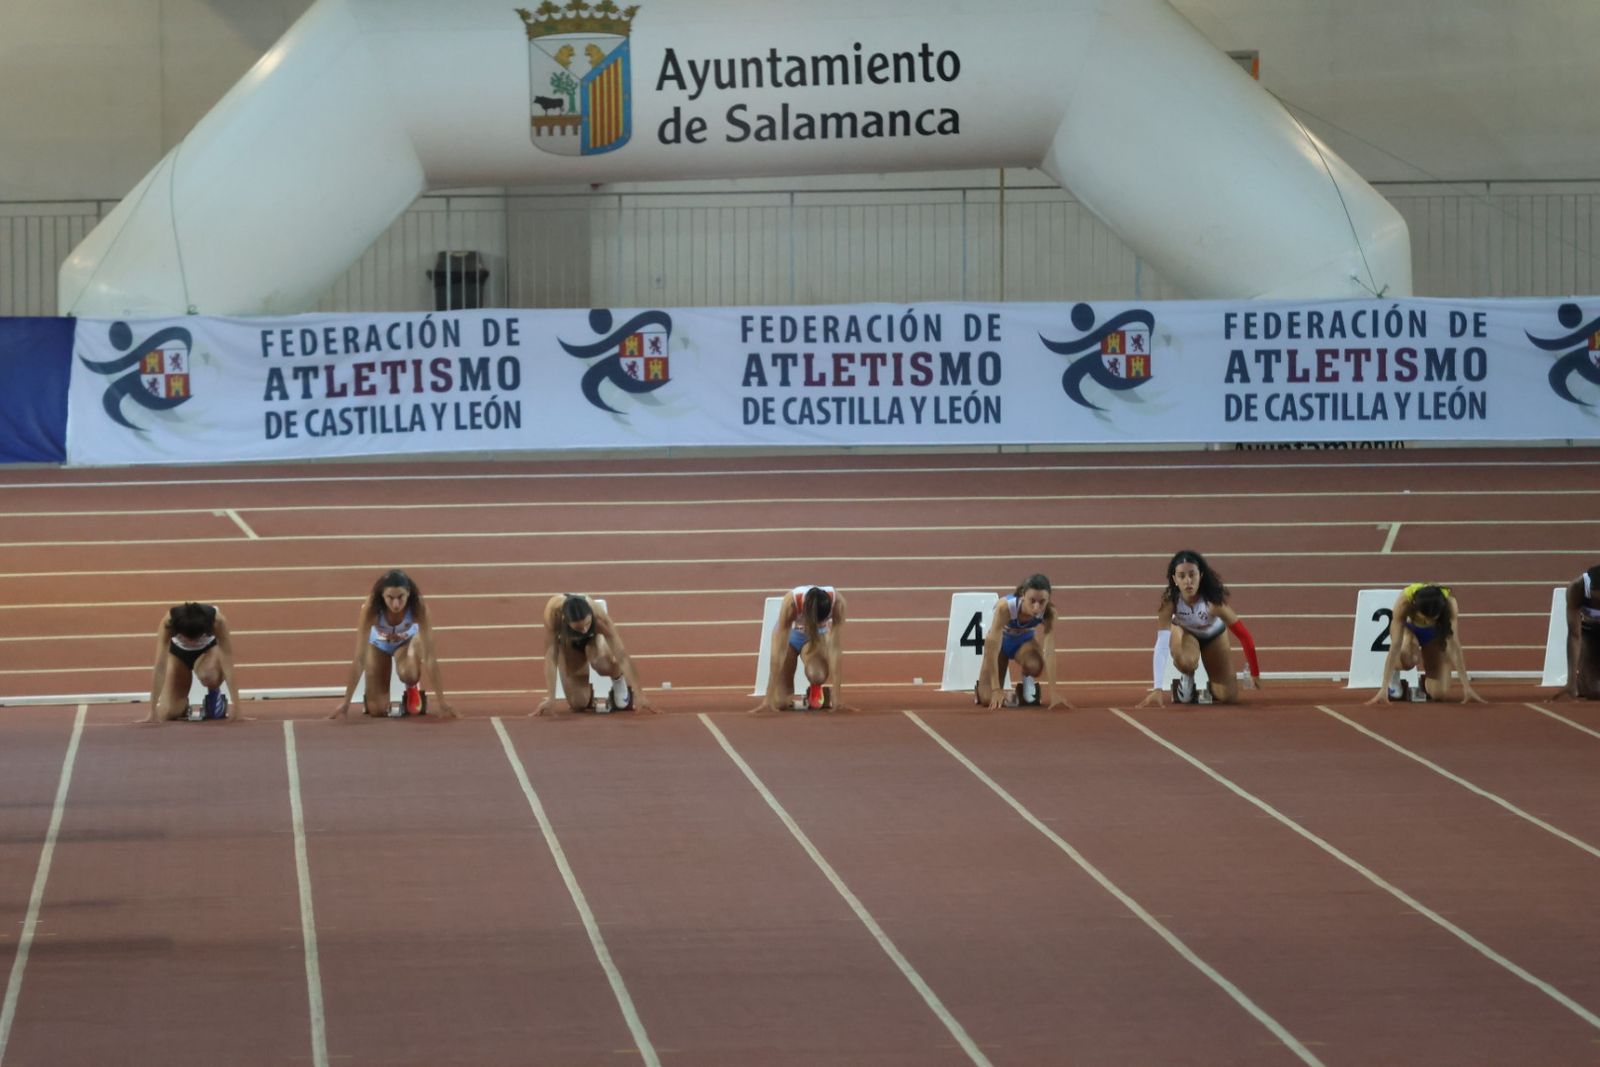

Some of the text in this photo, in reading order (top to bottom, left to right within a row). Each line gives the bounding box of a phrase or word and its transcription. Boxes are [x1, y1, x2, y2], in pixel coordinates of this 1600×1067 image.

[656, 42, 961, 100] Ayuntamiento
[658, 103, 960, 145] de Salamanca
[260, 314, 521, 358] FEDERACIÓN DE
[740, 308, 1001, 344] FEDERACIÓN DE
[1224, 304, 1487, 340] FEDERACIÓN DE
[263, 355, 521, 401] ATLETISMO
[742, 351, 1002, 387] ATLETISMO
[1224, 347, 1488, 384] ATLETISMO
[265, 394, 522, 440] DE CASTILLA Y LEÓN
[743, 390, 1002, 425] DE CASTILLA Y LEÓN
[1224, 386, 1487, 422] DE CASTILLA Y LEÓN
[959, 611, 985, 656] 4
[1370, 608, 1393, 652] 2
